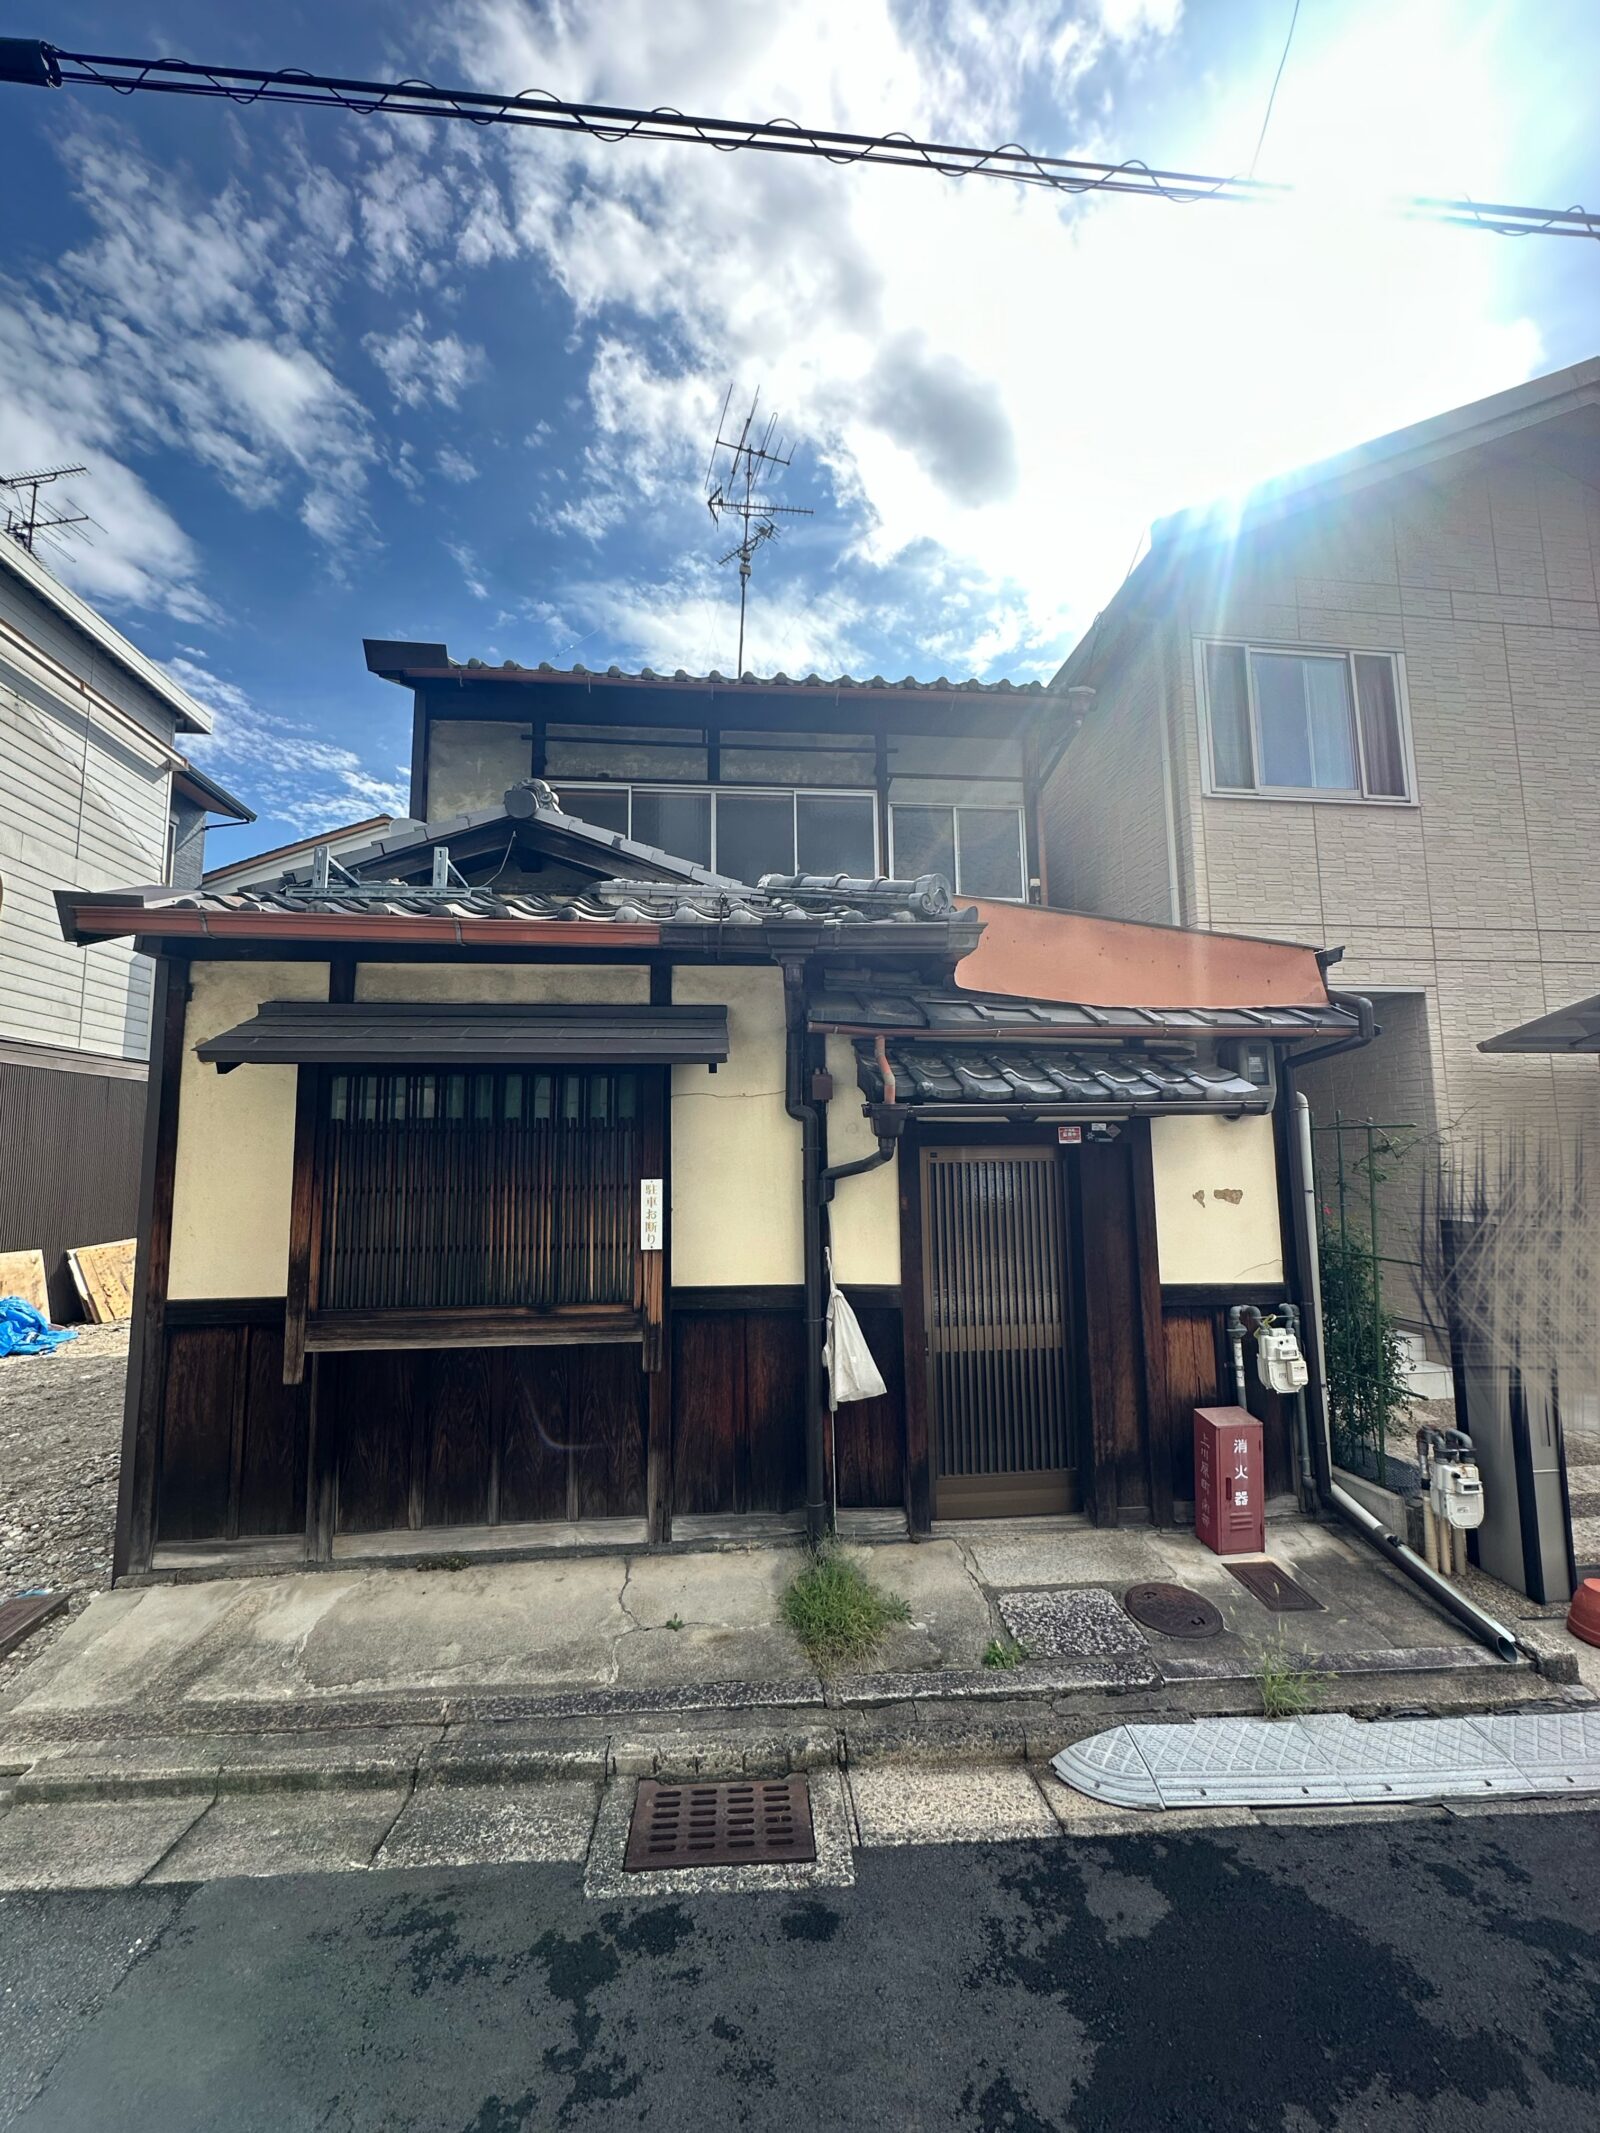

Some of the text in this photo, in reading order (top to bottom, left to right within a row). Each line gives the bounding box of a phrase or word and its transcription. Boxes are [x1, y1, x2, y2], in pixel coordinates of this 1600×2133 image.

[645, 1184, 657, 1245] 駐車お断り
[1234, 1439, 1248, 1506] 消火器
